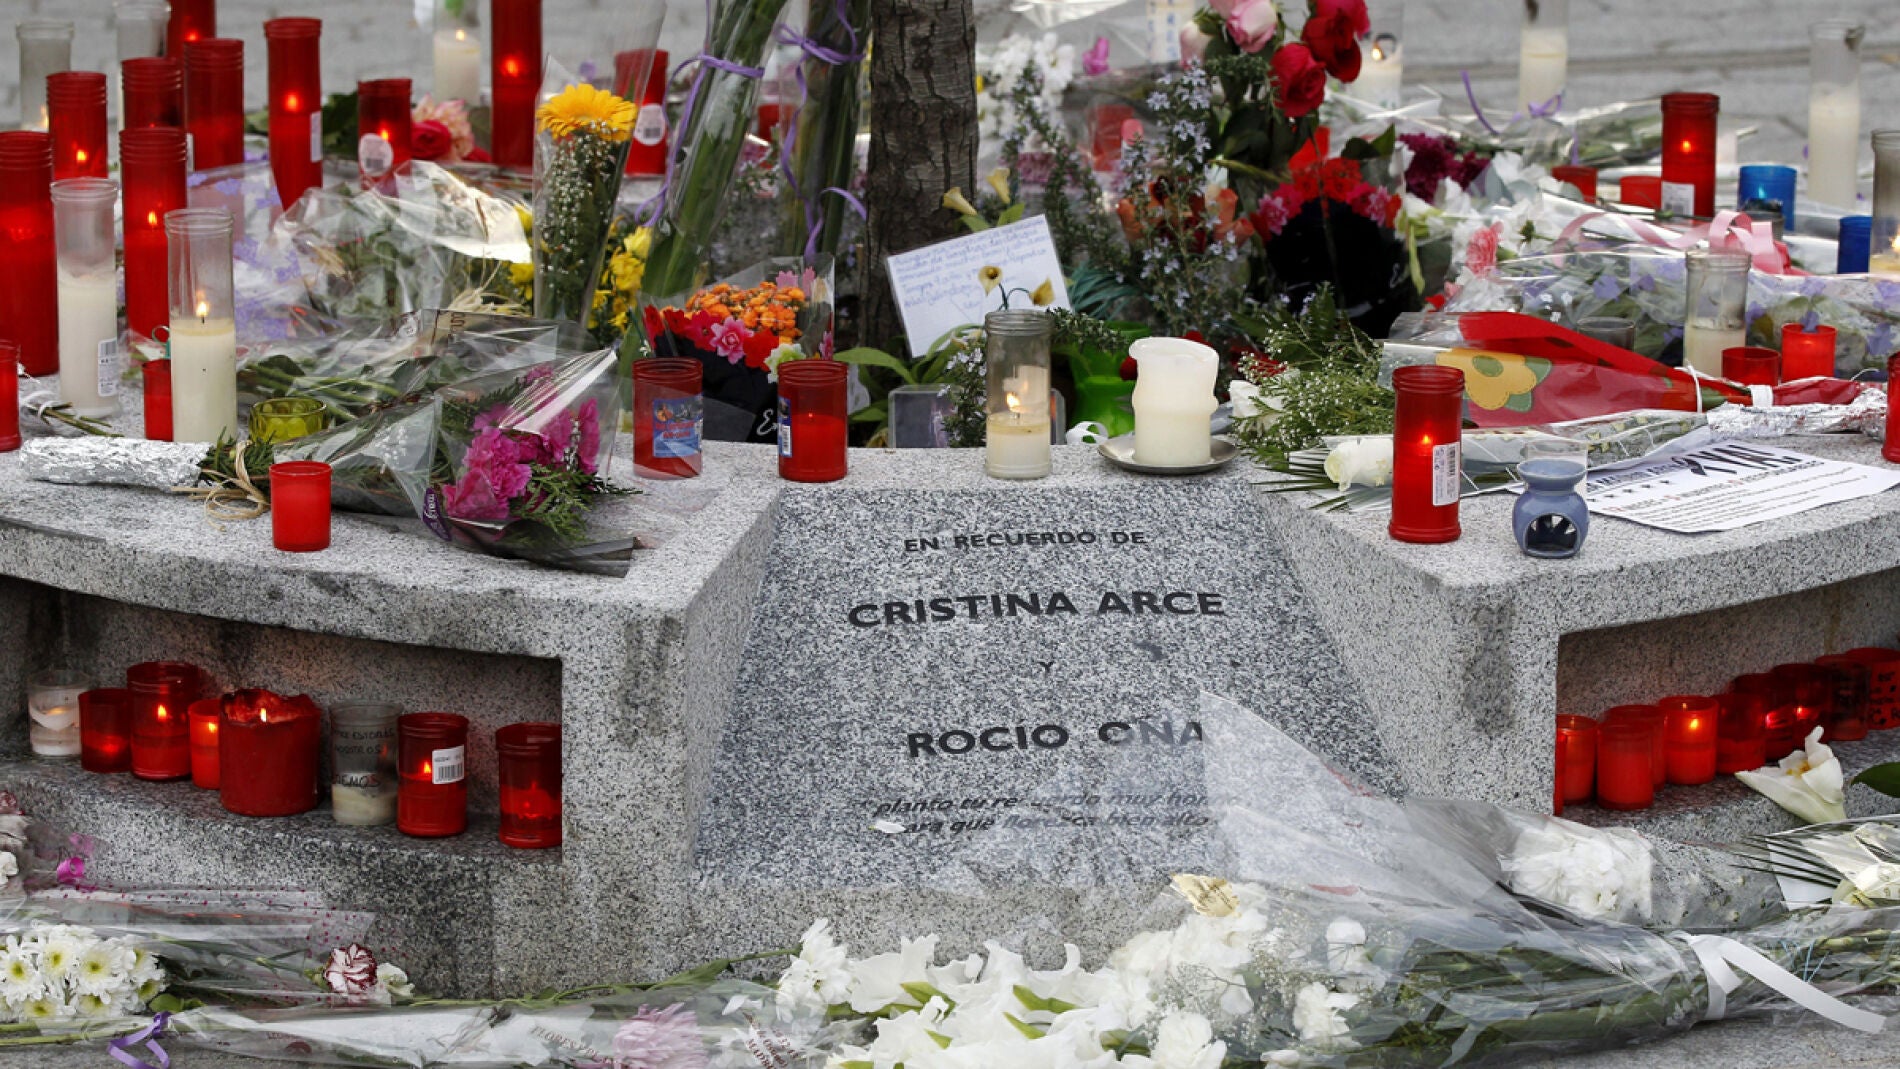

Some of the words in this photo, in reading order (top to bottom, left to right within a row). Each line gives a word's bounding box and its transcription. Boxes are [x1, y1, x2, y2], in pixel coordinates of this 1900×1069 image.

[905, 538, 939, 552] EN
[954, 531, 1097, 549] RECUERDO
[1111, 531, 1149, 545] DE
[848, 591, 1079, 628] CRISTINA
[1100, 590, 1225, 616] ARCE
[1039, 661, 1054, 676] Y
[898, 816, 945, 834] ara
